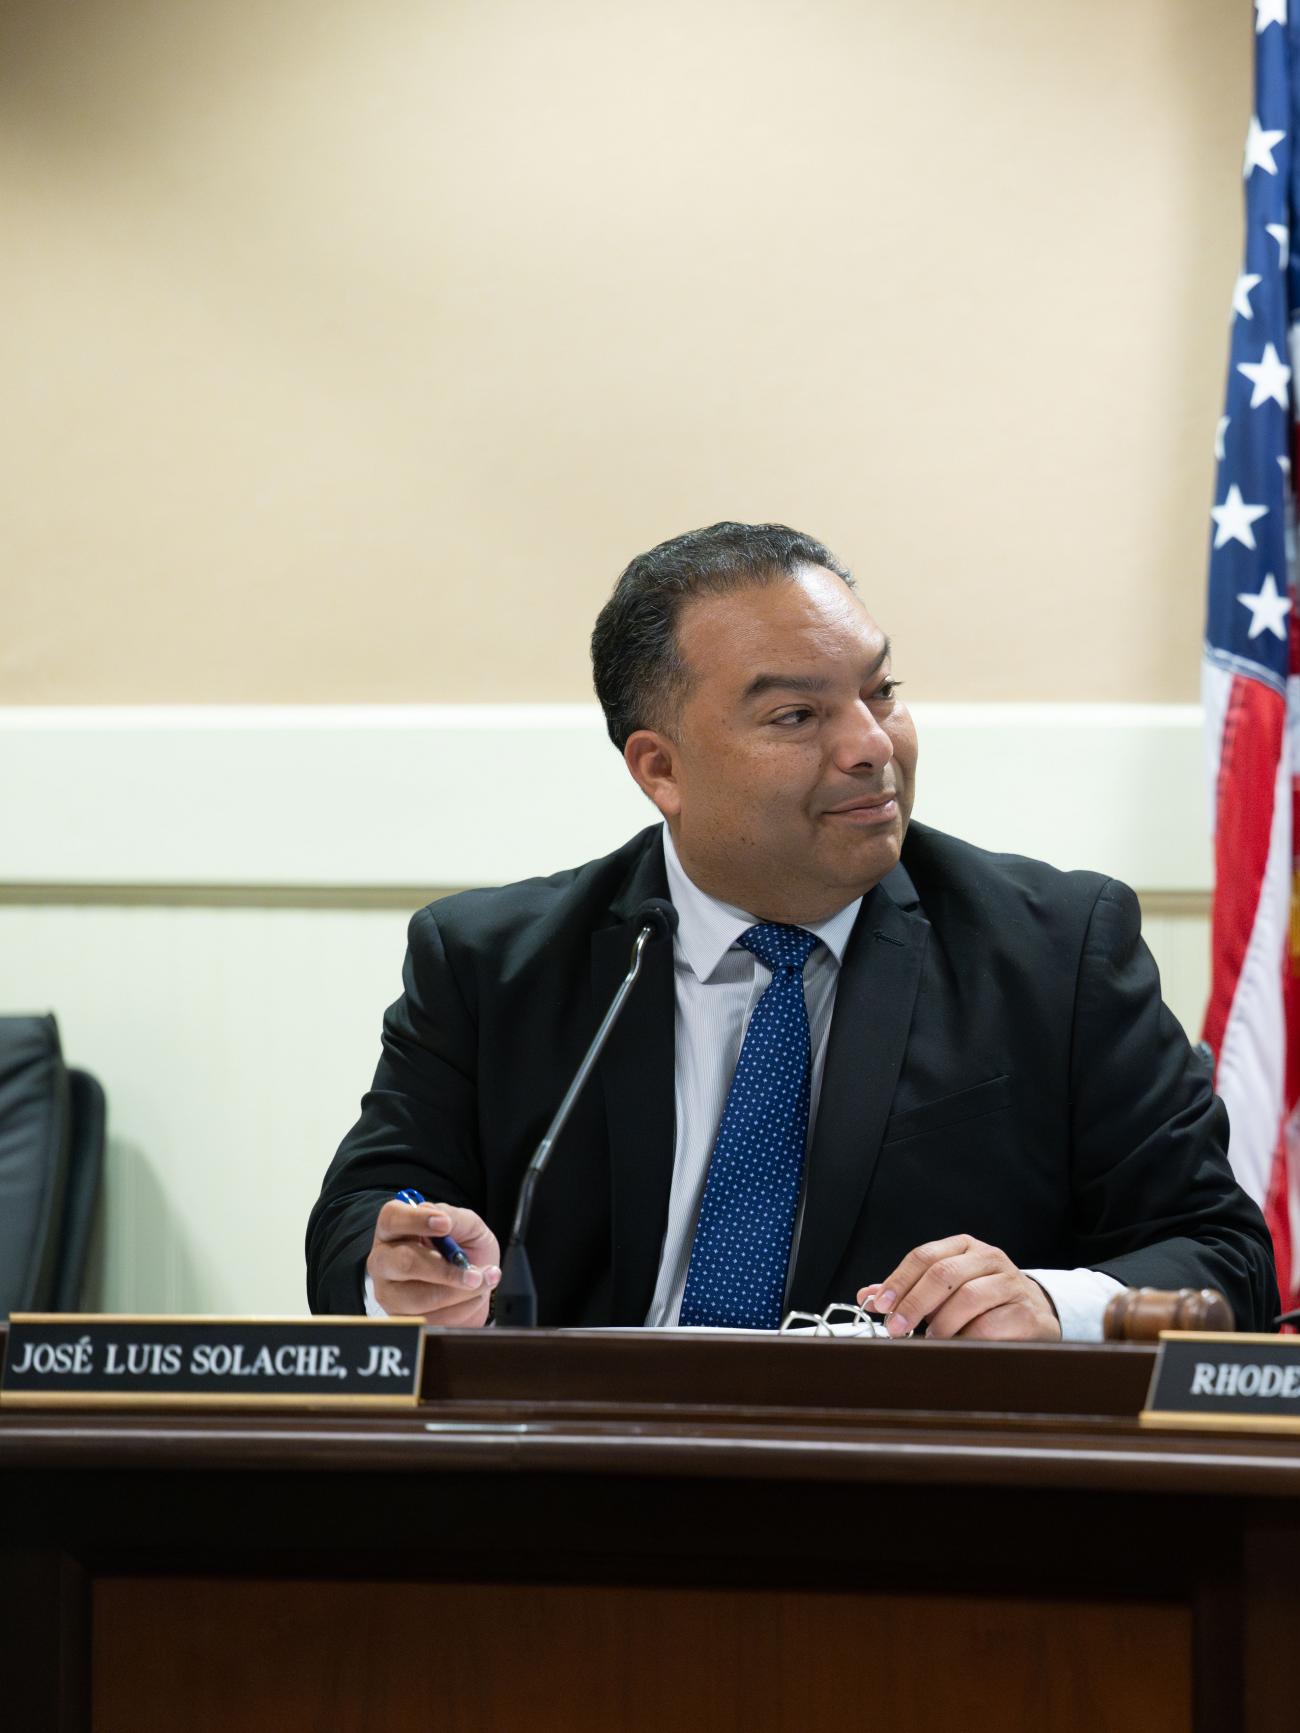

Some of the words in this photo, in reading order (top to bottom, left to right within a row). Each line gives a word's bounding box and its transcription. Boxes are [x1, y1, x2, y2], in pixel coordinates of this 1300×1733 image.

[12, 1335, 93, 1373] JOSÉ
[104, 1343, 182, 1375] LUIS
[190, 1344, 347, 1379] SOLACHE,
[357, 1346, 411, 1377] JR.
